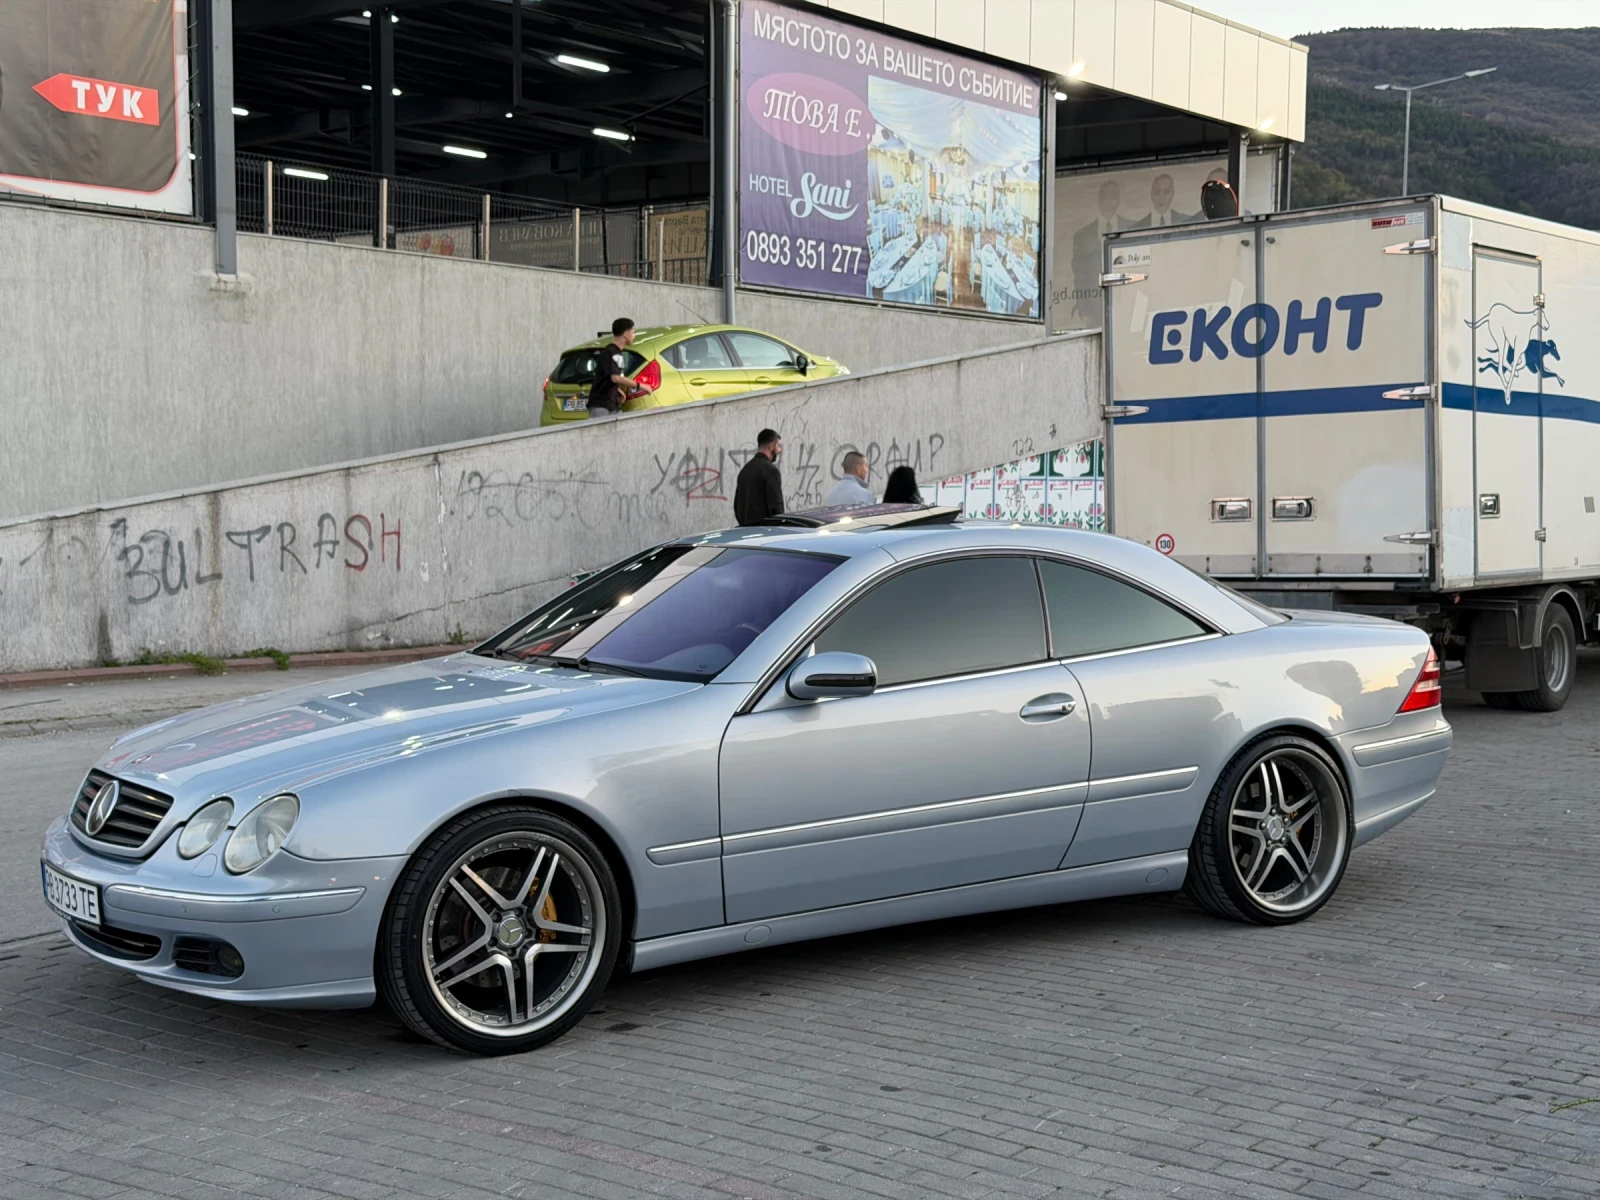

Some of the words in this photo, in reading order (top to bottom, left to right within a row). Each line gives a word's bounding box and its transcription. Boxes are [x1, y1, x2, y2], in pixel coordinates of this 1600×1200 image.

[754, 10, 850, 59] МЯСТОТО
[855, 38, 879, 69] ЗА
[883, 46, 955, 87] ВАШЕТО
[959, 67, 1033, 109] СЪБИТИЕ
[71, 80, 144, 119] ТУК
[762, 88, 840, 134] ТОВА
[749, 173, 792, 198] HOTEL
[790, 172, 859, 221] Sani
[746, 230, 791, 266] 0893
[796, 237, 826, 271] 351
[831, 243, 862, 275] 277
[1148, 292, 1383, 365] ЕКОНТ
[1159, 540, 1172, 549] 130
[55, 876, 78, 911] 3733
[79, 886, 97, 919] TE
